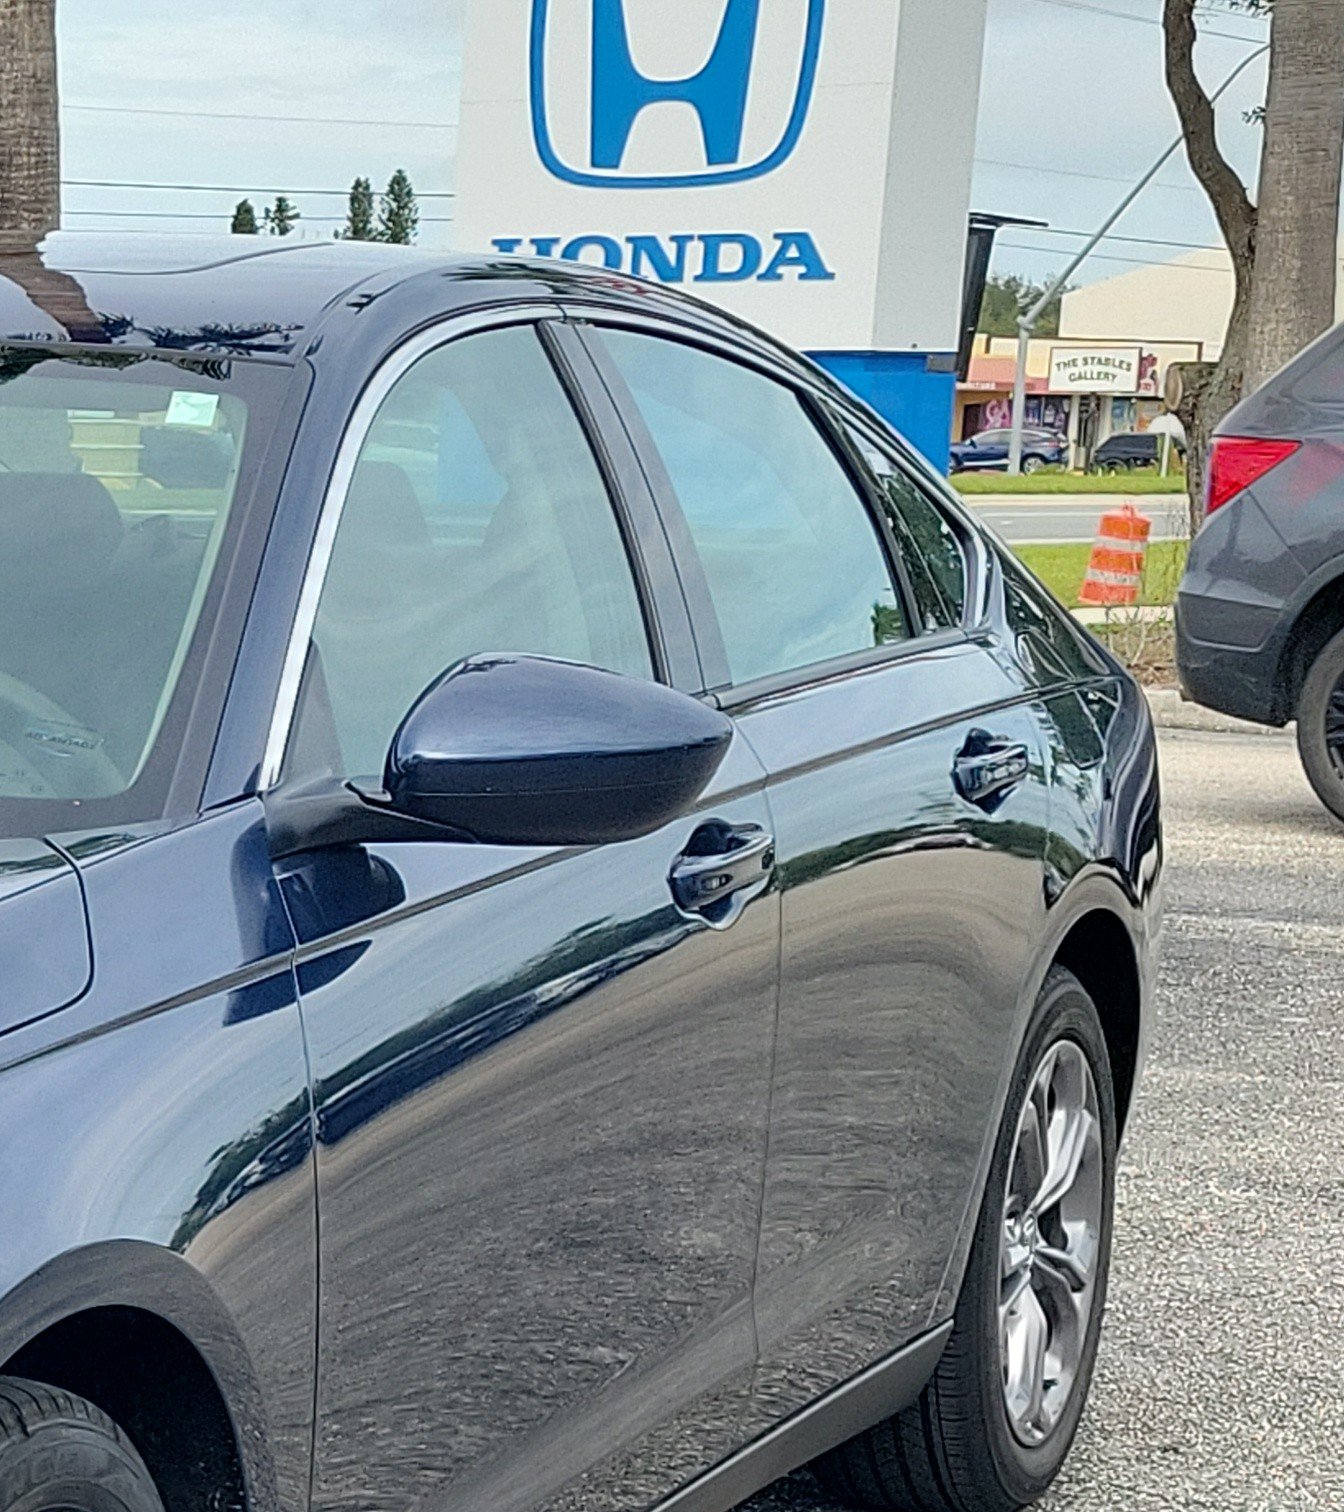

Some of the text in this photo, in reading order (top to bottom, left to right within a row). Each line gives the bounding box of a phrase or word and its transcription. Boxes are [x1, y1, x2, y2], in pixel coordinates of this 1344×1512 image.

[1054, 355, 1133, 373] THE STABLES
[1068, 370, 1118, 384] GALLERY
